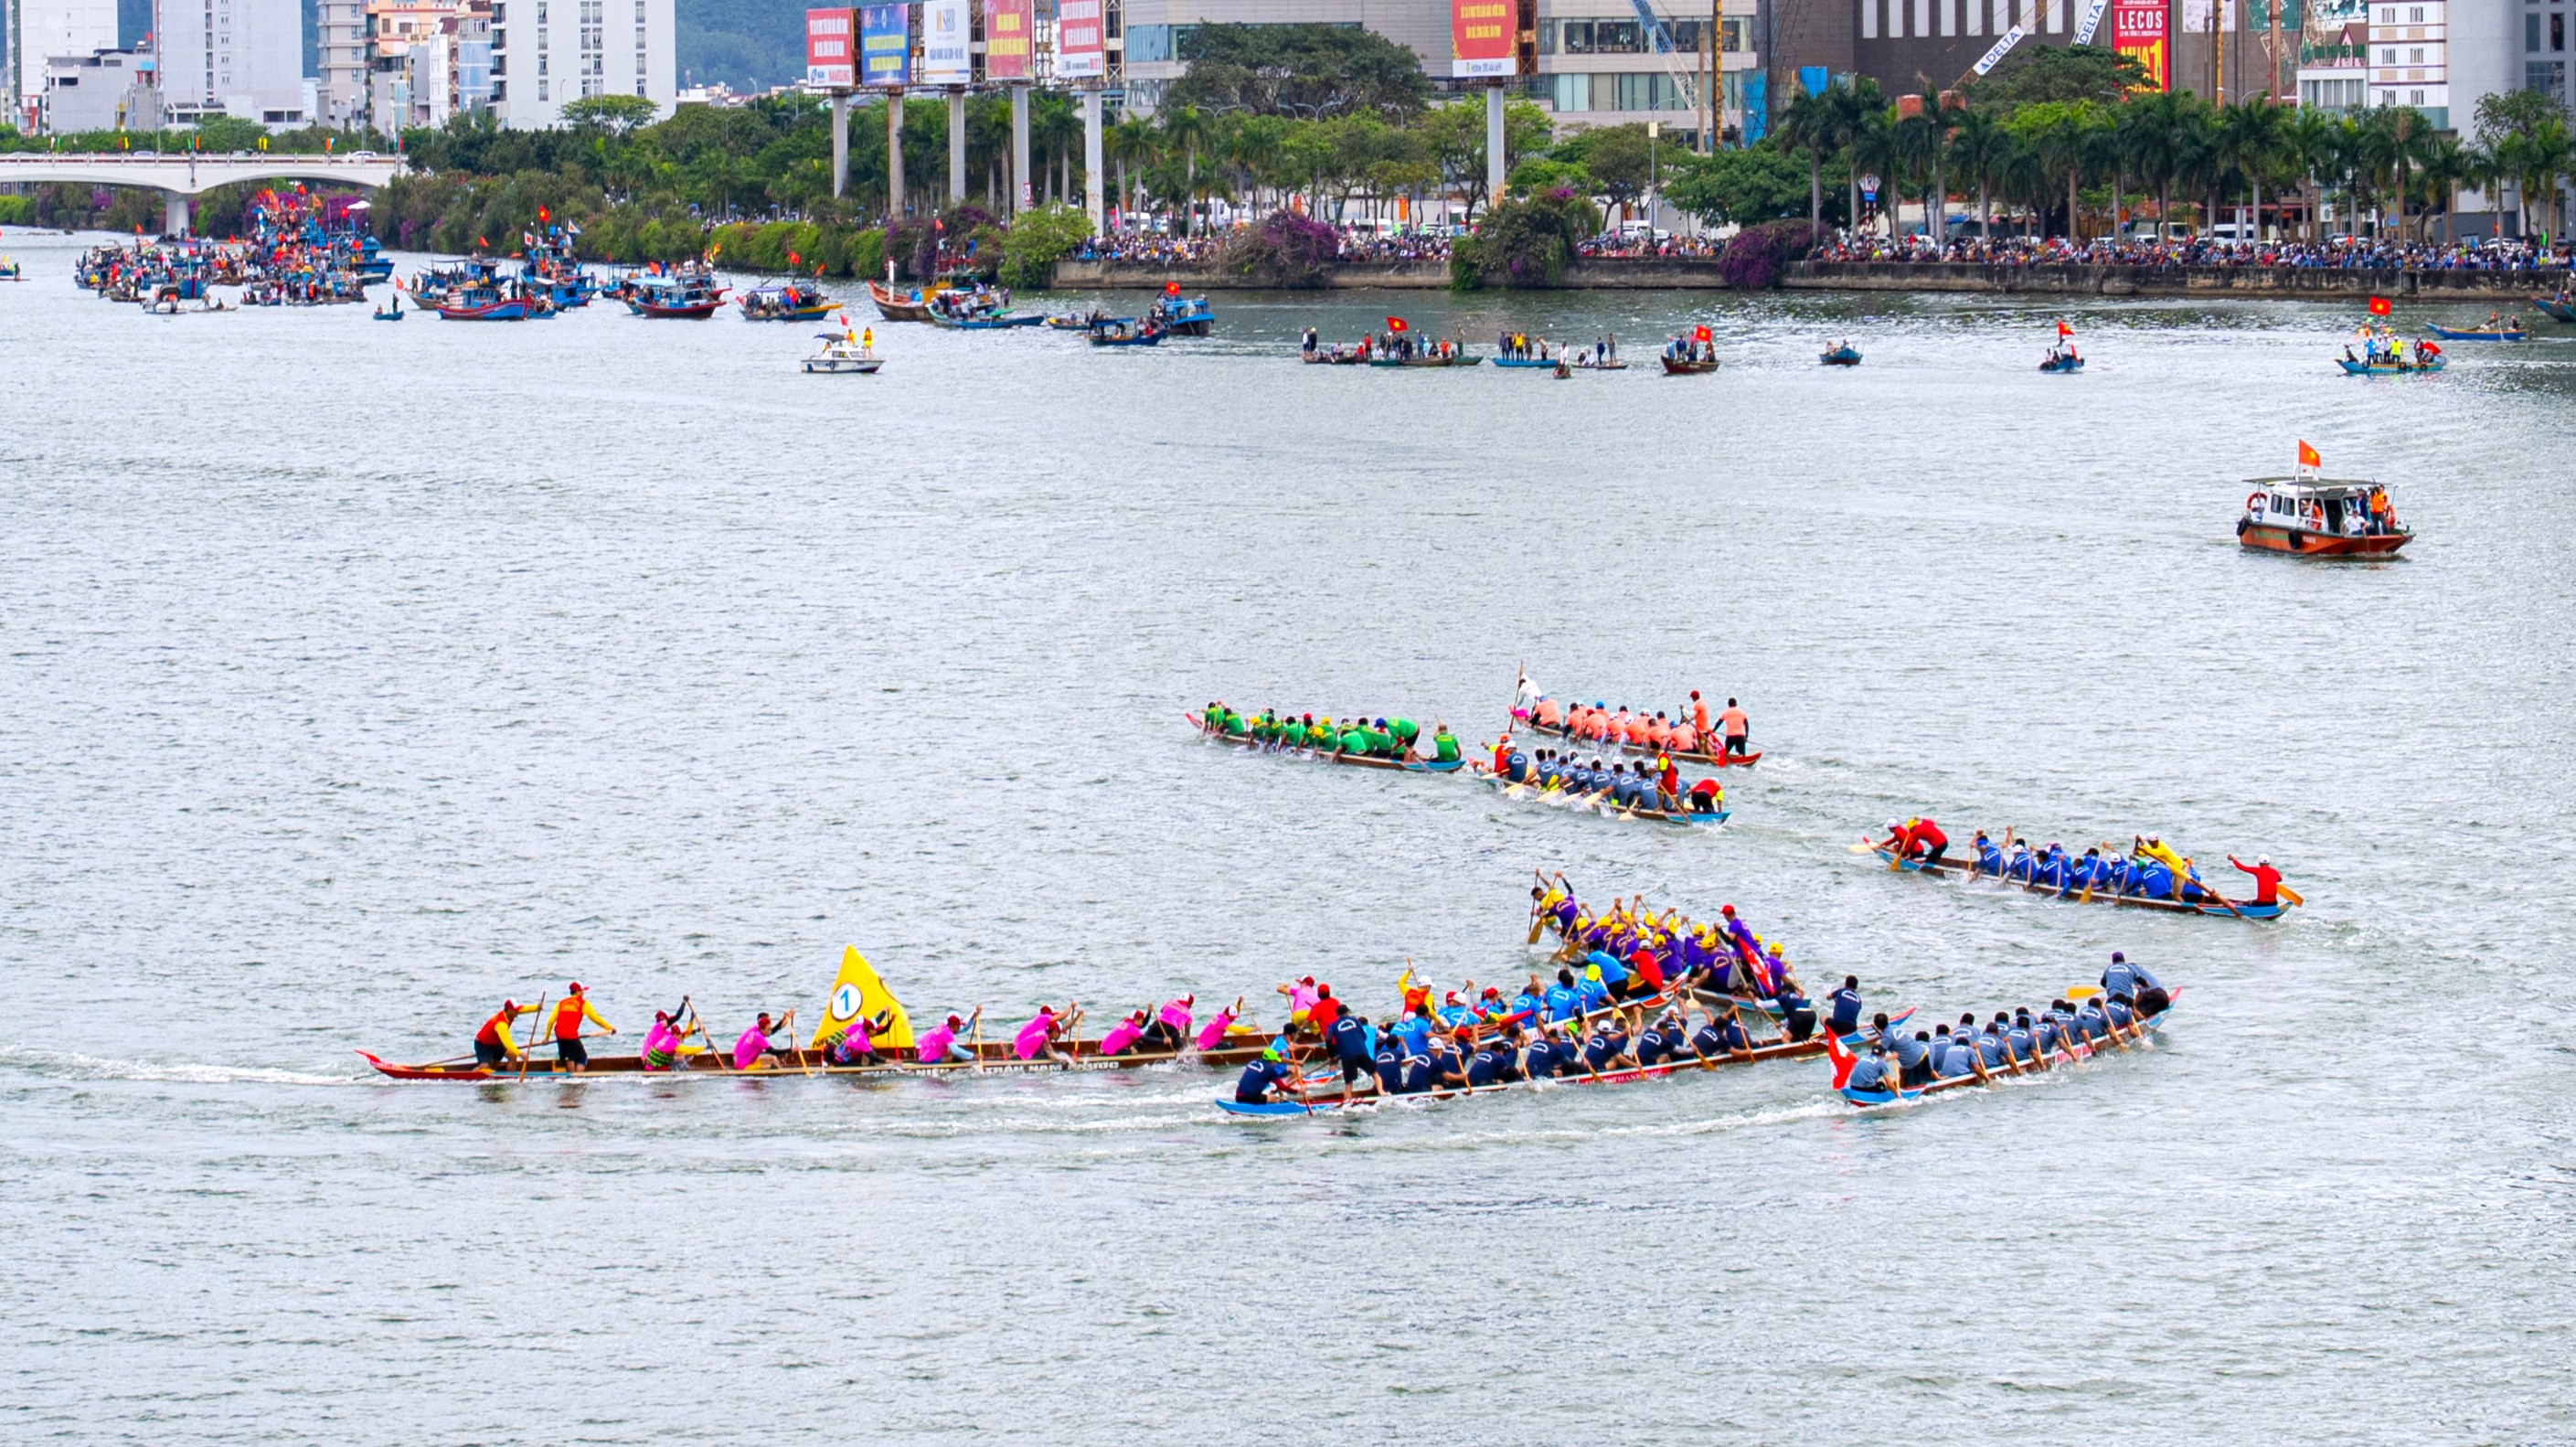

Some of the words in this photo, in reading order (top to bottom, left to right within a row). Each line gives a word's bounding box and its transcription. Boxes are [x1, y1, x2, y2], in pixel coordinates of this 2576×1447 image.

[2079, 4, 2103, 45] DELTA
[2118, 10, 2163, 30] LECOS
[1986, 31, 2020, 65] DELTA
[839, 988, 849, 1012] 1
